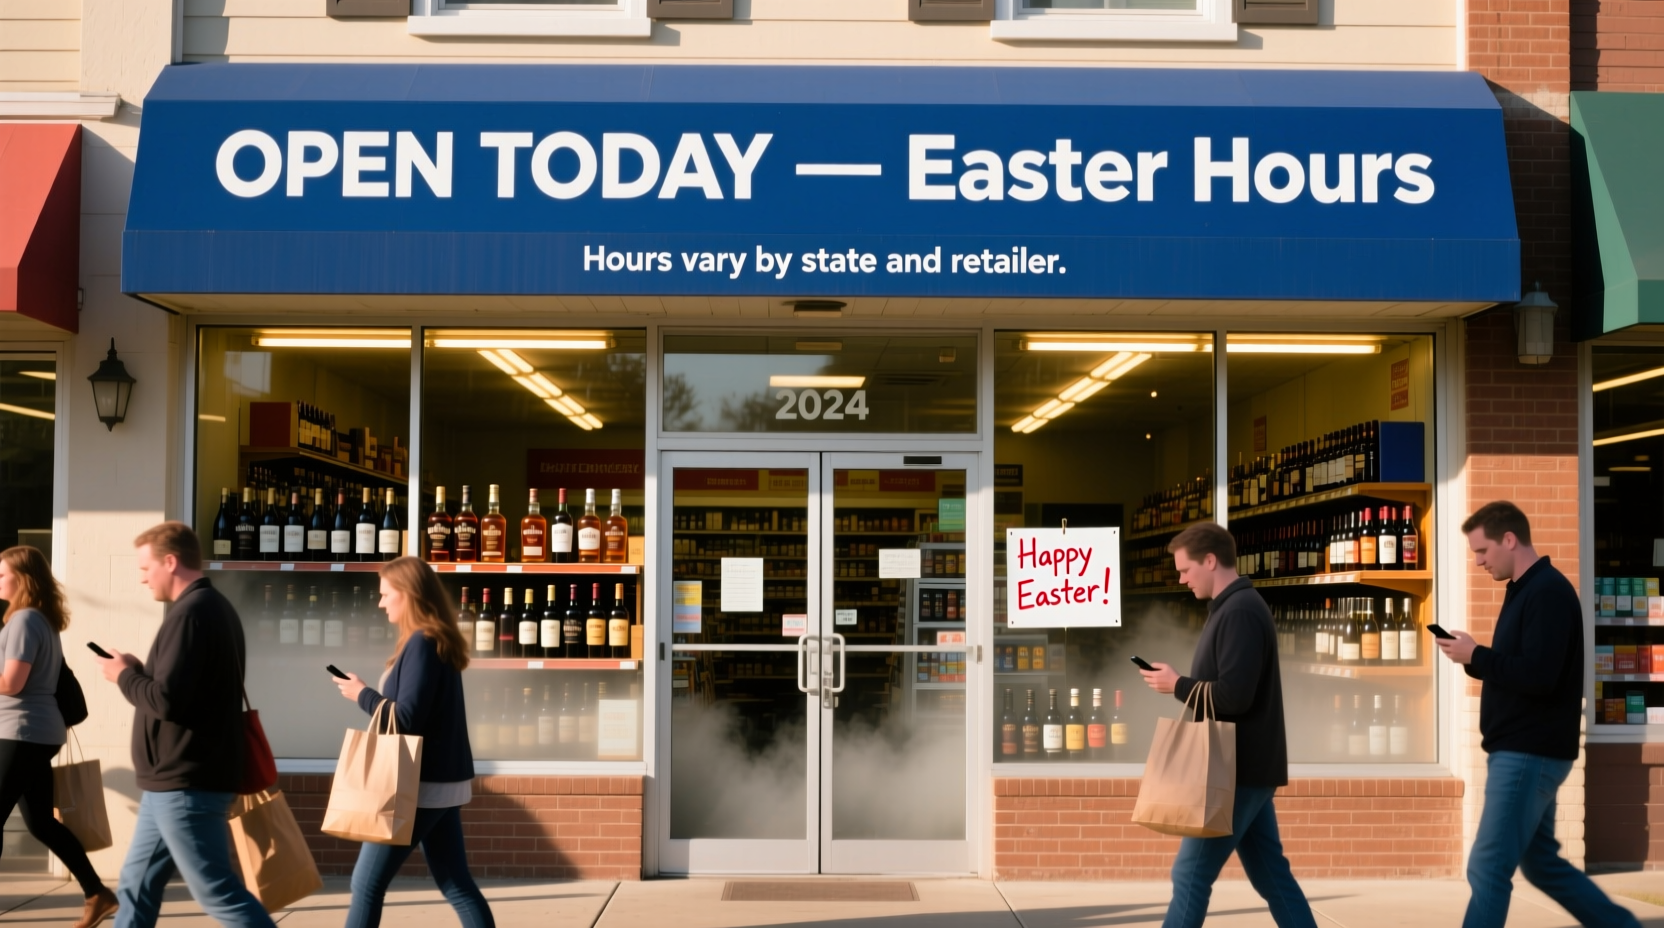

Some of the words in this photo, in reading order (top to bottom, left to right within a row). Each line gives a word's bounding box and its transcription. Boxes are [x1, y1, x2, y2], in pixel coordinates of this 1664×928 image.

[215, 129, 454, 199] OPEN
[480, 131, 774, 201] TODAY
[908, 134, 1168, 203] Easter
[1194, 136, 1435, 204] Hours
[583, 245, 673, 272] Hours
[681, 252, 748, 280] vary
[755, 245, 793, 280] by
[801, 248, 878, 274] state
[886, 246, 941, 274] and
[951, 246, 1067, 274] retailer.
[775, 389, 870, 421] 2024
[1017, 537, 1093, 577] Happy
[1017, 566, 1111, 610] Easter!
